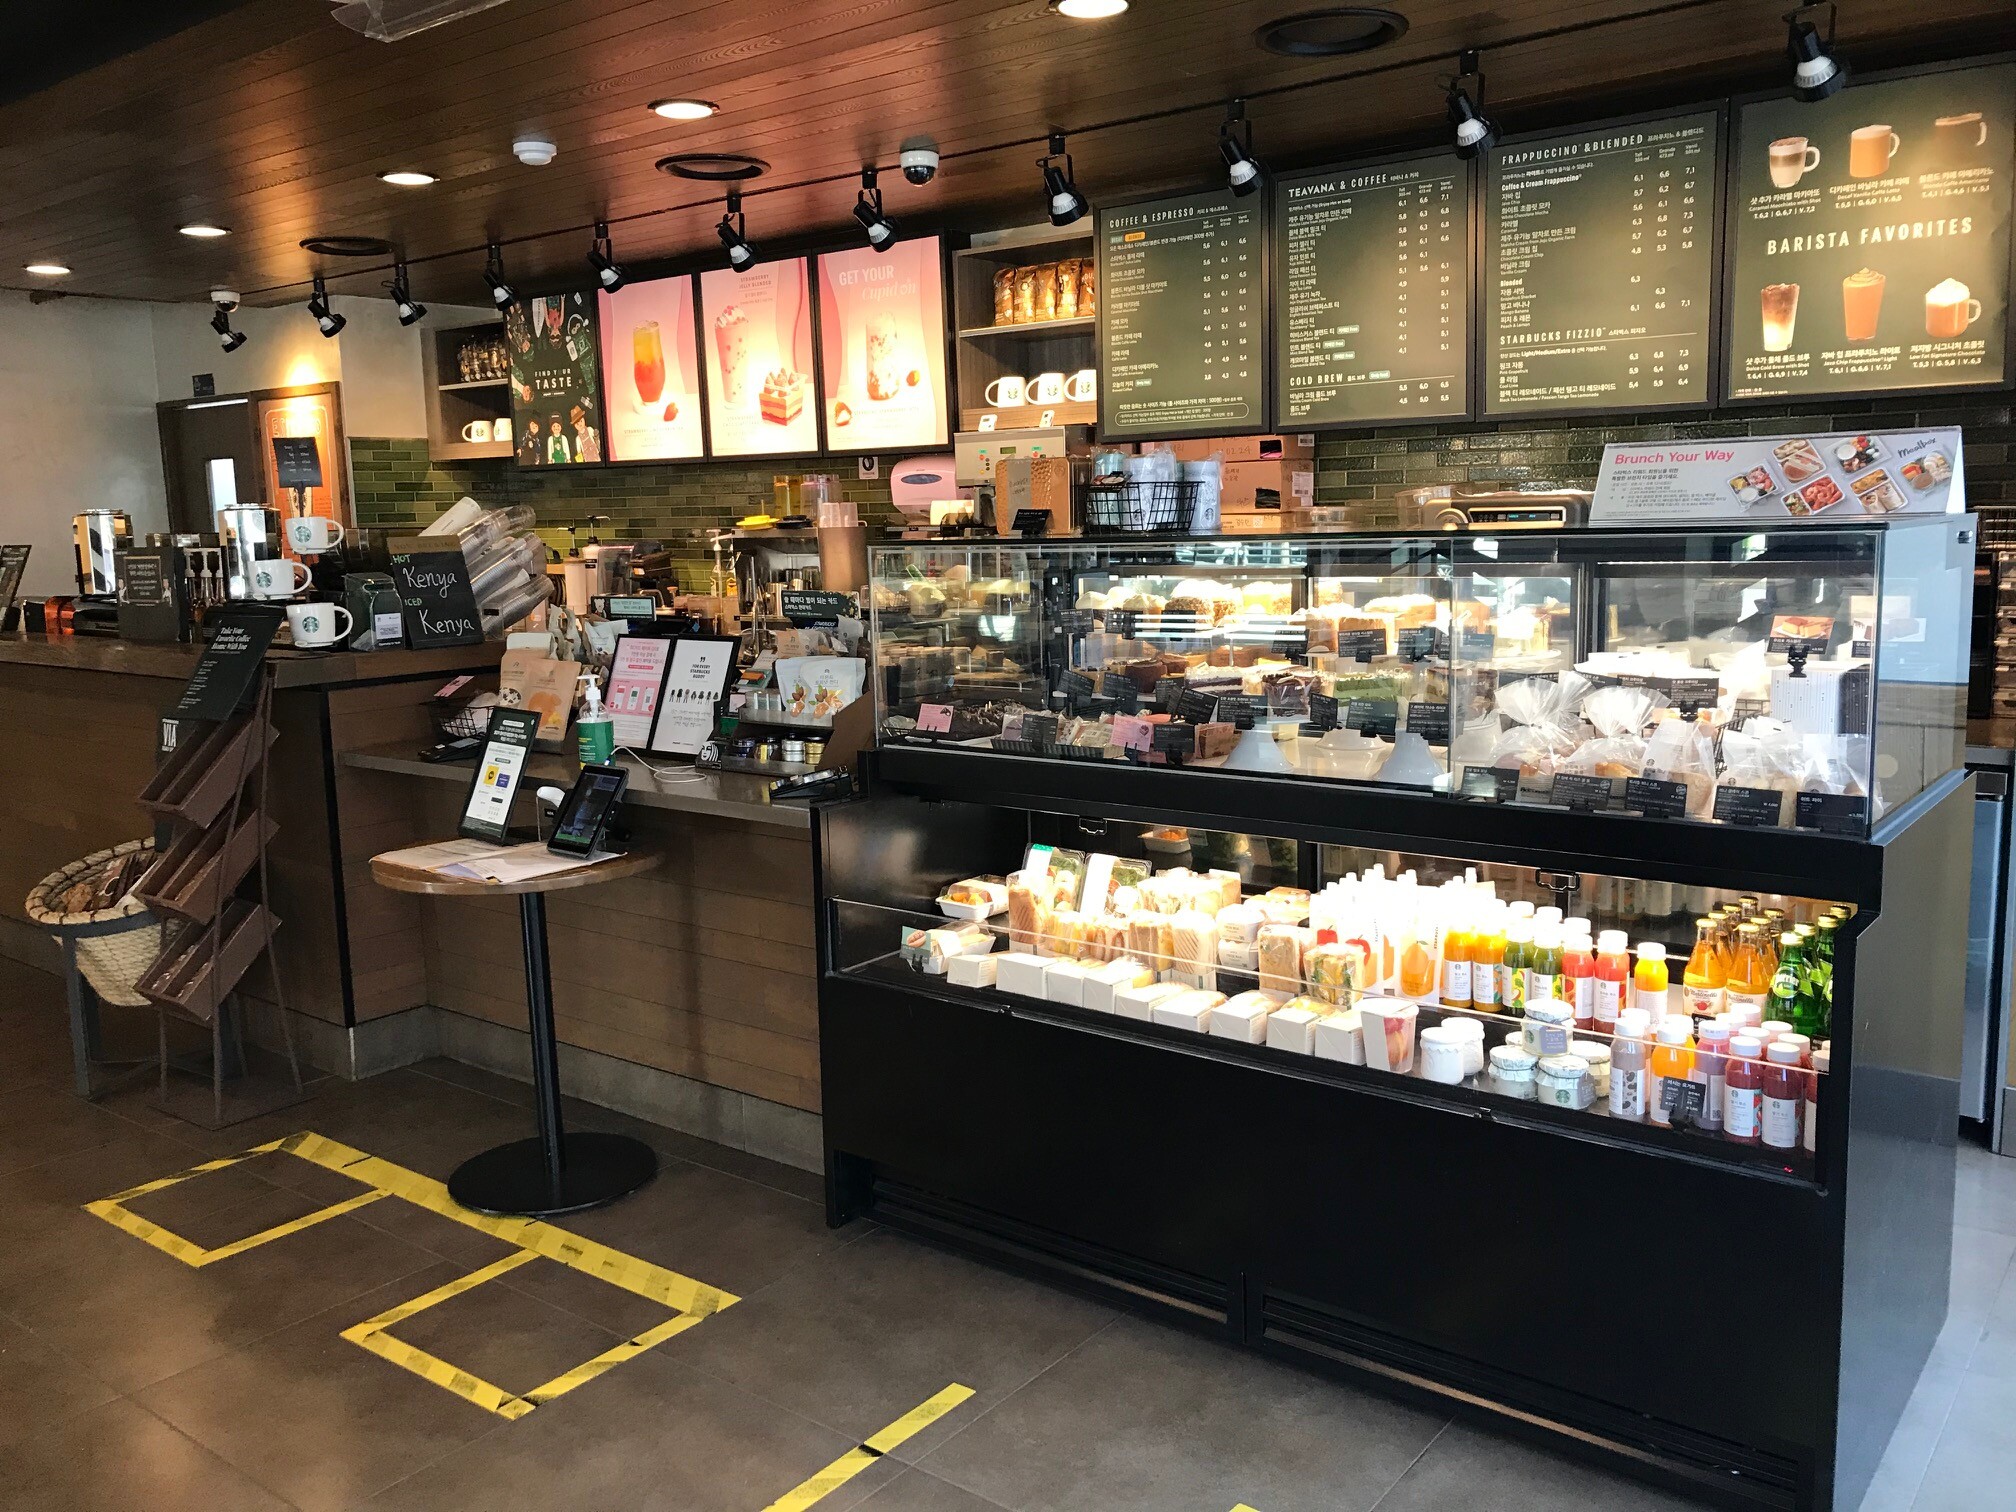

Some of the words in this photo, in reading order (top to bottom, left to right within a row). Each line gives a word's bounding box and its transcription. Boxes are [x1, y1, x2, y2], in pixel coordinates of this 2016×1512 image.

[1502, 145, 1578, 165] FRAPPUCCINO
[1289, 184, 1335, 197] TEAVANA
[1340, 180, 1346, 189] &
[1351, 173, 1387, 188] COFFEE
[1501, 182, 1520, 191] Coffee
[1109, 216, 1138, 228] COFFEE
[1142, 215, 1148, 223] &
[1152, 207, 1194, 221] ESPRESSO
[1767, 230, 1850, 256] BARISTA
[1860, 216, 1973, 245] FAVORITES
[839, 270, 859, 286] GET
[862, 265, 894, 283] YOUR
[1500, 330, 1561, 345] STARBUCKS
[535, 377, 572, 390] TASTE
[1290, 376, 1312, 386] COLD
[1318, 373, 1343, 384] BREW
[1614, 452, 1664, 465] Brunch
[1669, 451, 1702, 463] Your
[1704, 449, 1735, 462] Way
[393, 555, 411, 564] HOT
[402, 566, 457, 598] Kenya
[405, 598, 422, 606] ICED
[419, 609, 474, 636] Kenya
[163, 723, 176, 747] VIA
